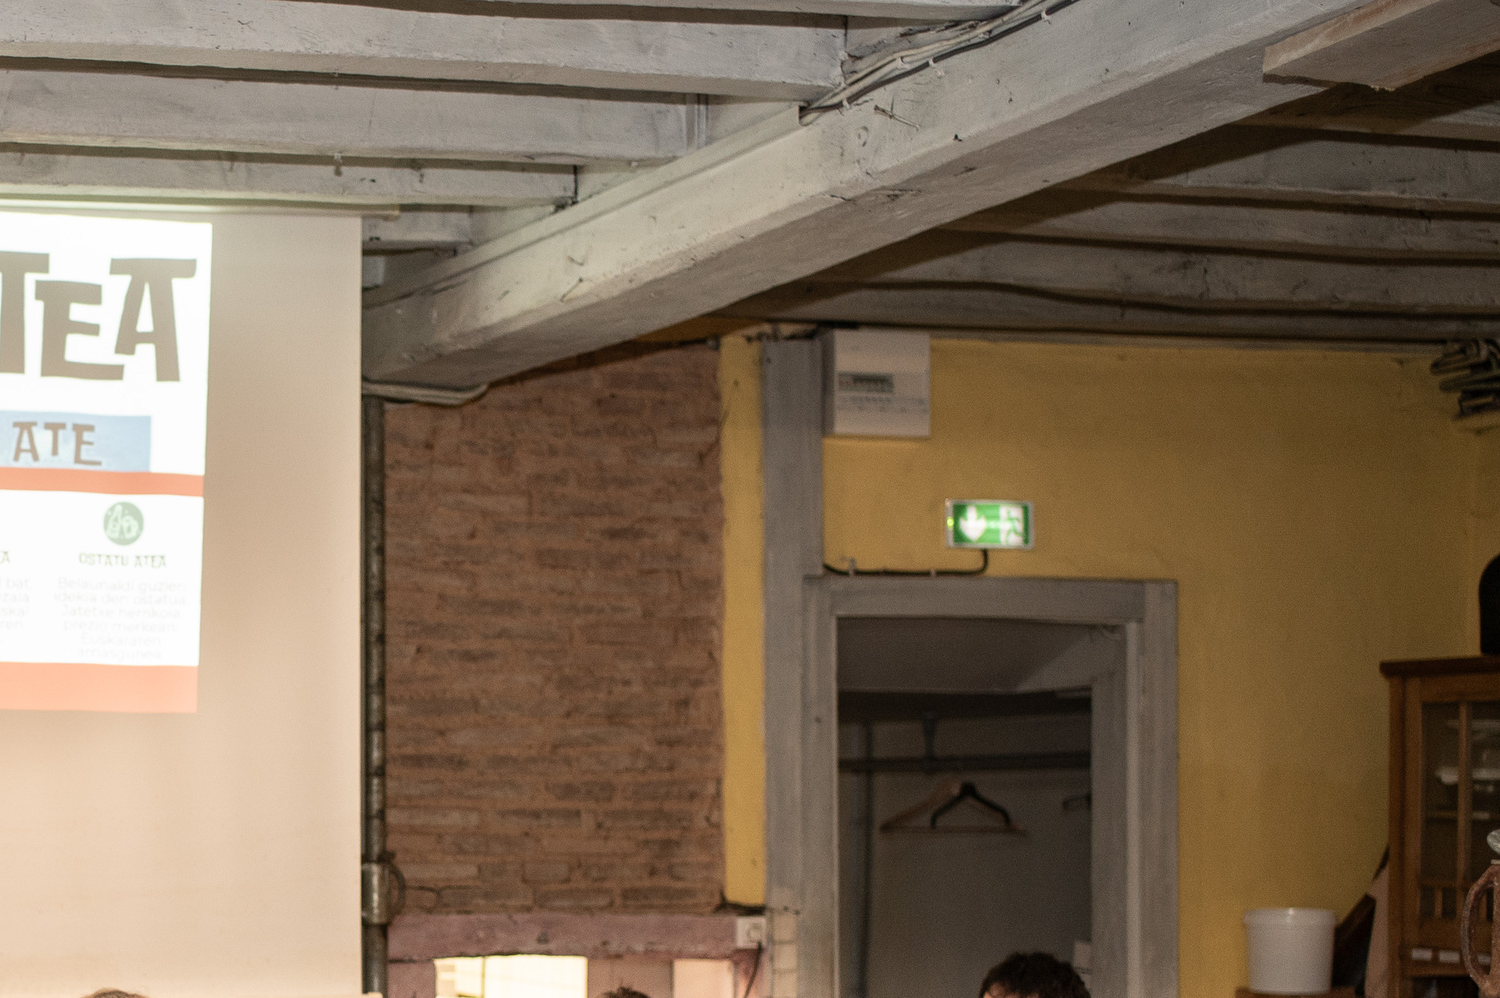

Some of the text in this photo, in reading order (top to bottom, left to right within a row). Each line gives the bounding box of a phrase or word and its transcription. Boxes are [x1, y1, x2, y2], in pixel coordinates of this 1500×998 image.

[12, 421, 103, 466] ATE
[78, 552, 167, 568] OSTATU ATEA
